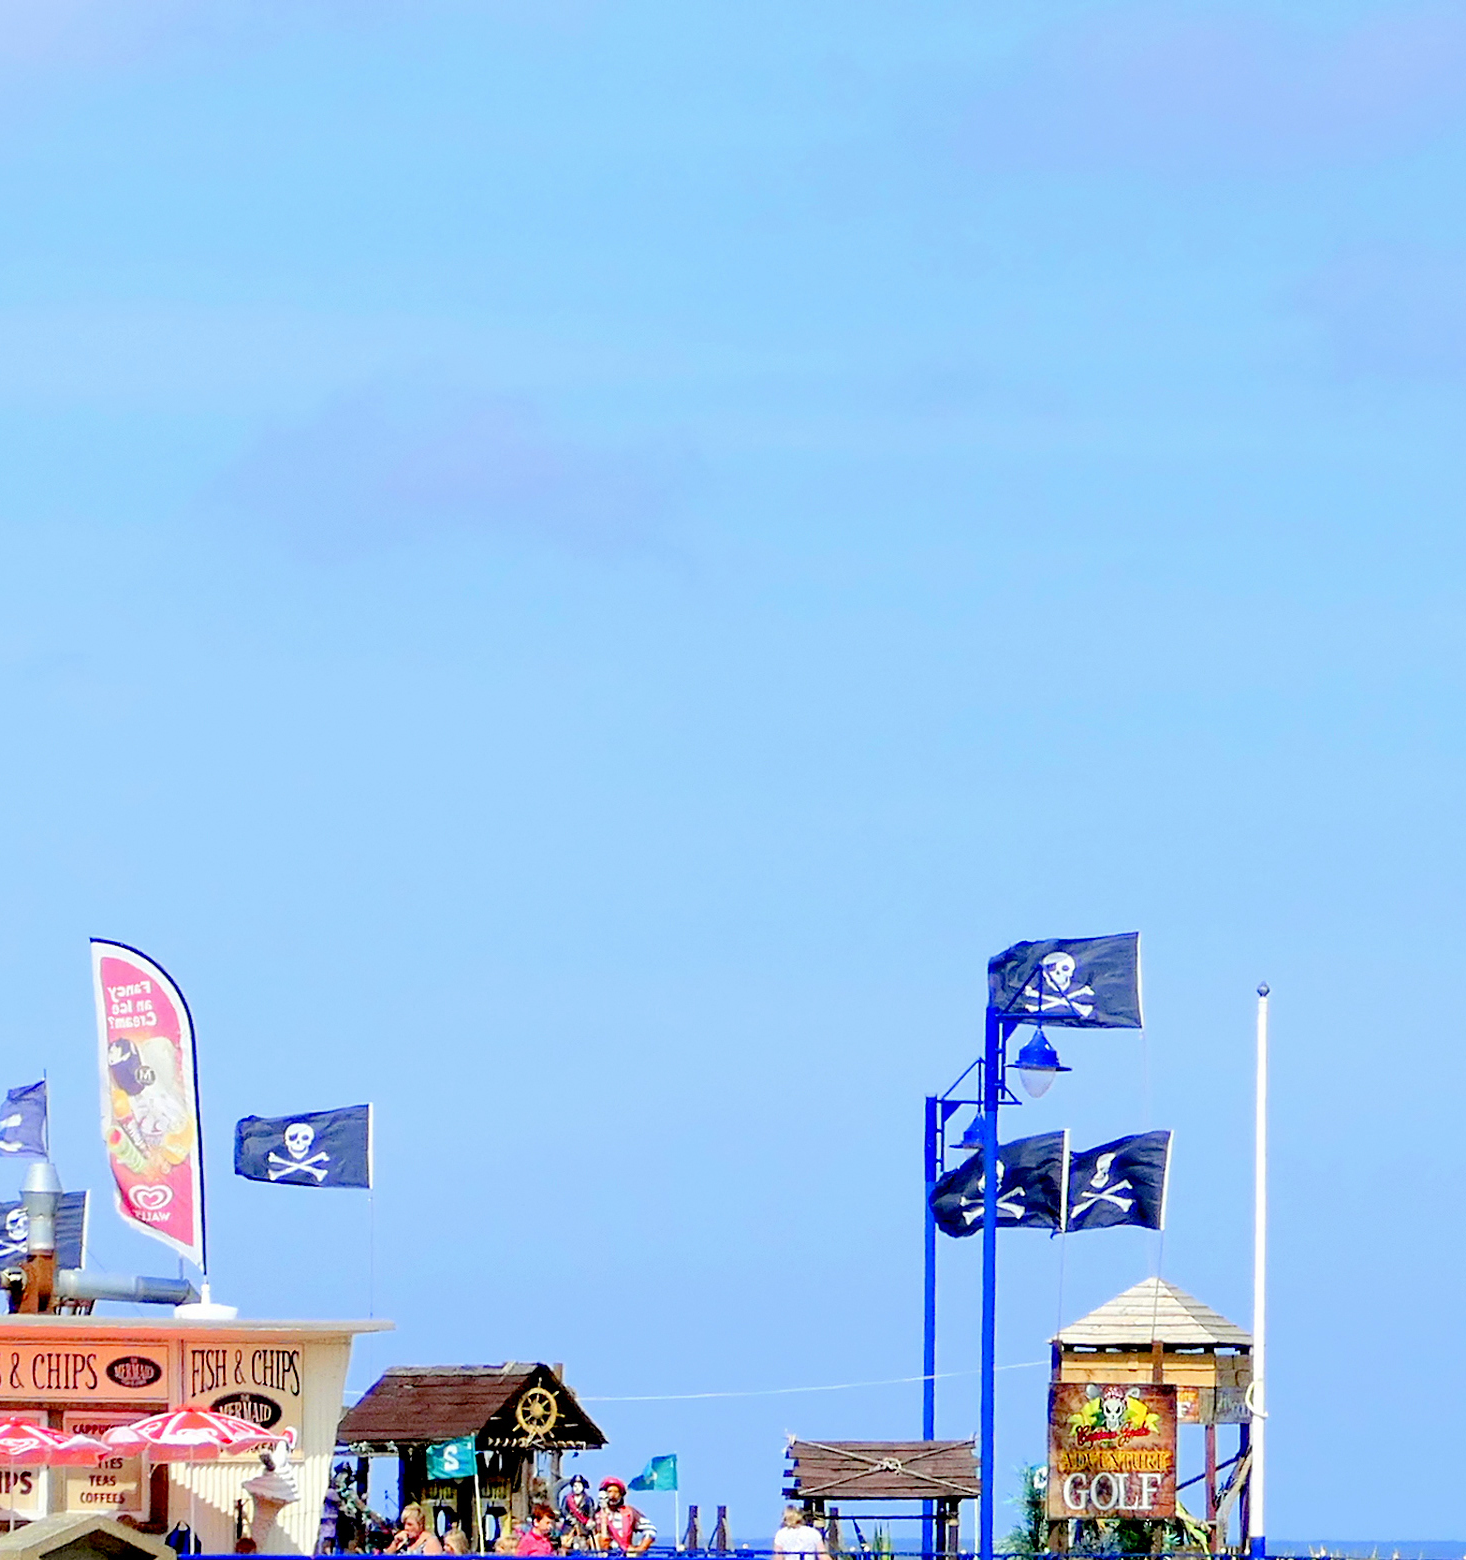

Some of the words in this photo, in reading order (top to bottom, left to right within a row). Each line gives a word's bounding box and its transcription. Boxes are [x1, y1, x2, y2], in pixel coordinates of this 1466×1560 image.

[10, 1352, 24, 1388] &
[33, 1352, 98, 1390] CHIPS
[191, 1350, 227, 1397] FISH
[235, 1350, 246, 1385] &
[252, 1350, 300, 1396] CHIPS
[1061, 1451, 1170, 1471] ADVENTURE
[89, 1475, 116, 1486] TEAS
[1064, 1472, 1162, 1510] GOLF
[80, 1492, 125, 1504] COFFEES
